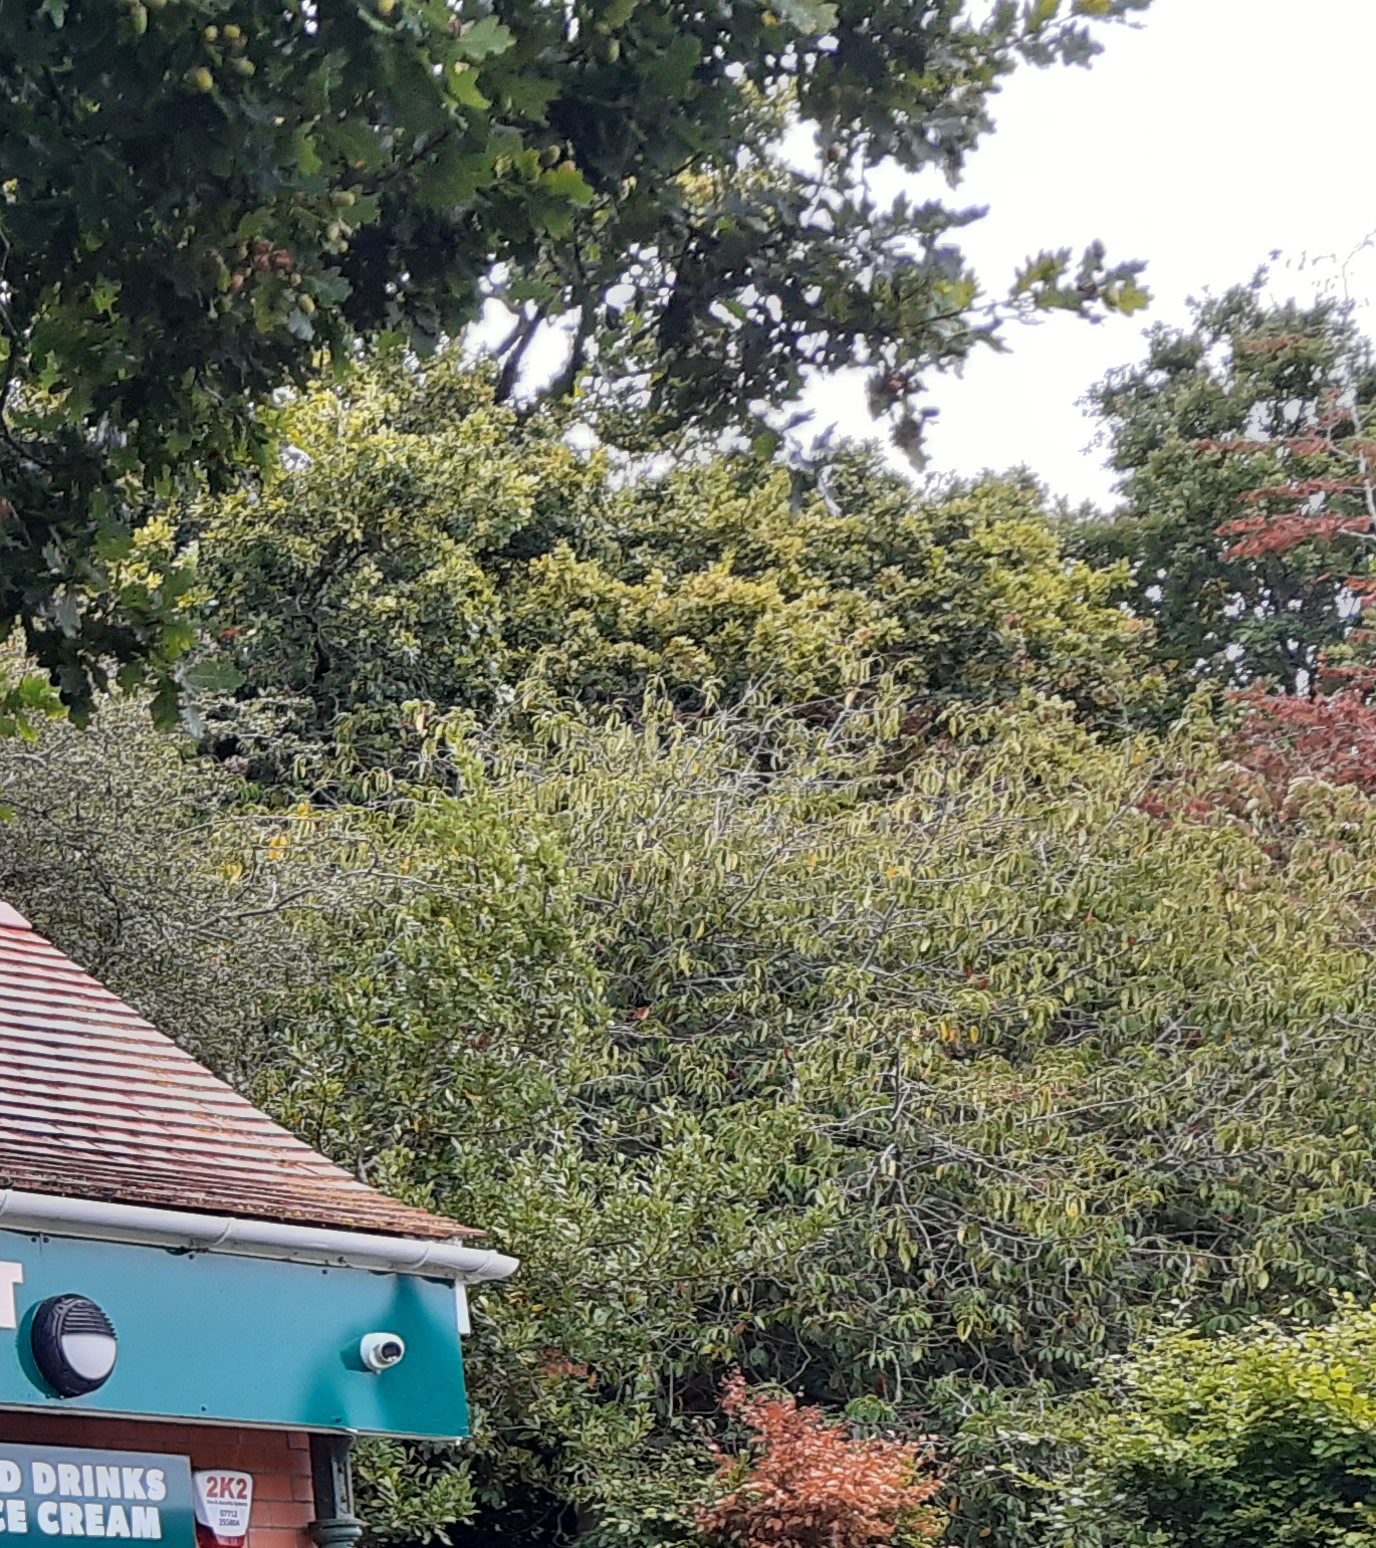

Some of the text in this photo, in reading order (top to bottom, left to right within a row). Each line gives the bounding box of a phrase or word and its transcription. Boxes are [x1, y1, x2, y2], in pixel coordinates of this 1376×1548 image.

[32, 1461, 166, 1500] DRINKS
[206, 1476, 248, 1499] 2K2
[37, 1502, 162, 1539] CREAM
